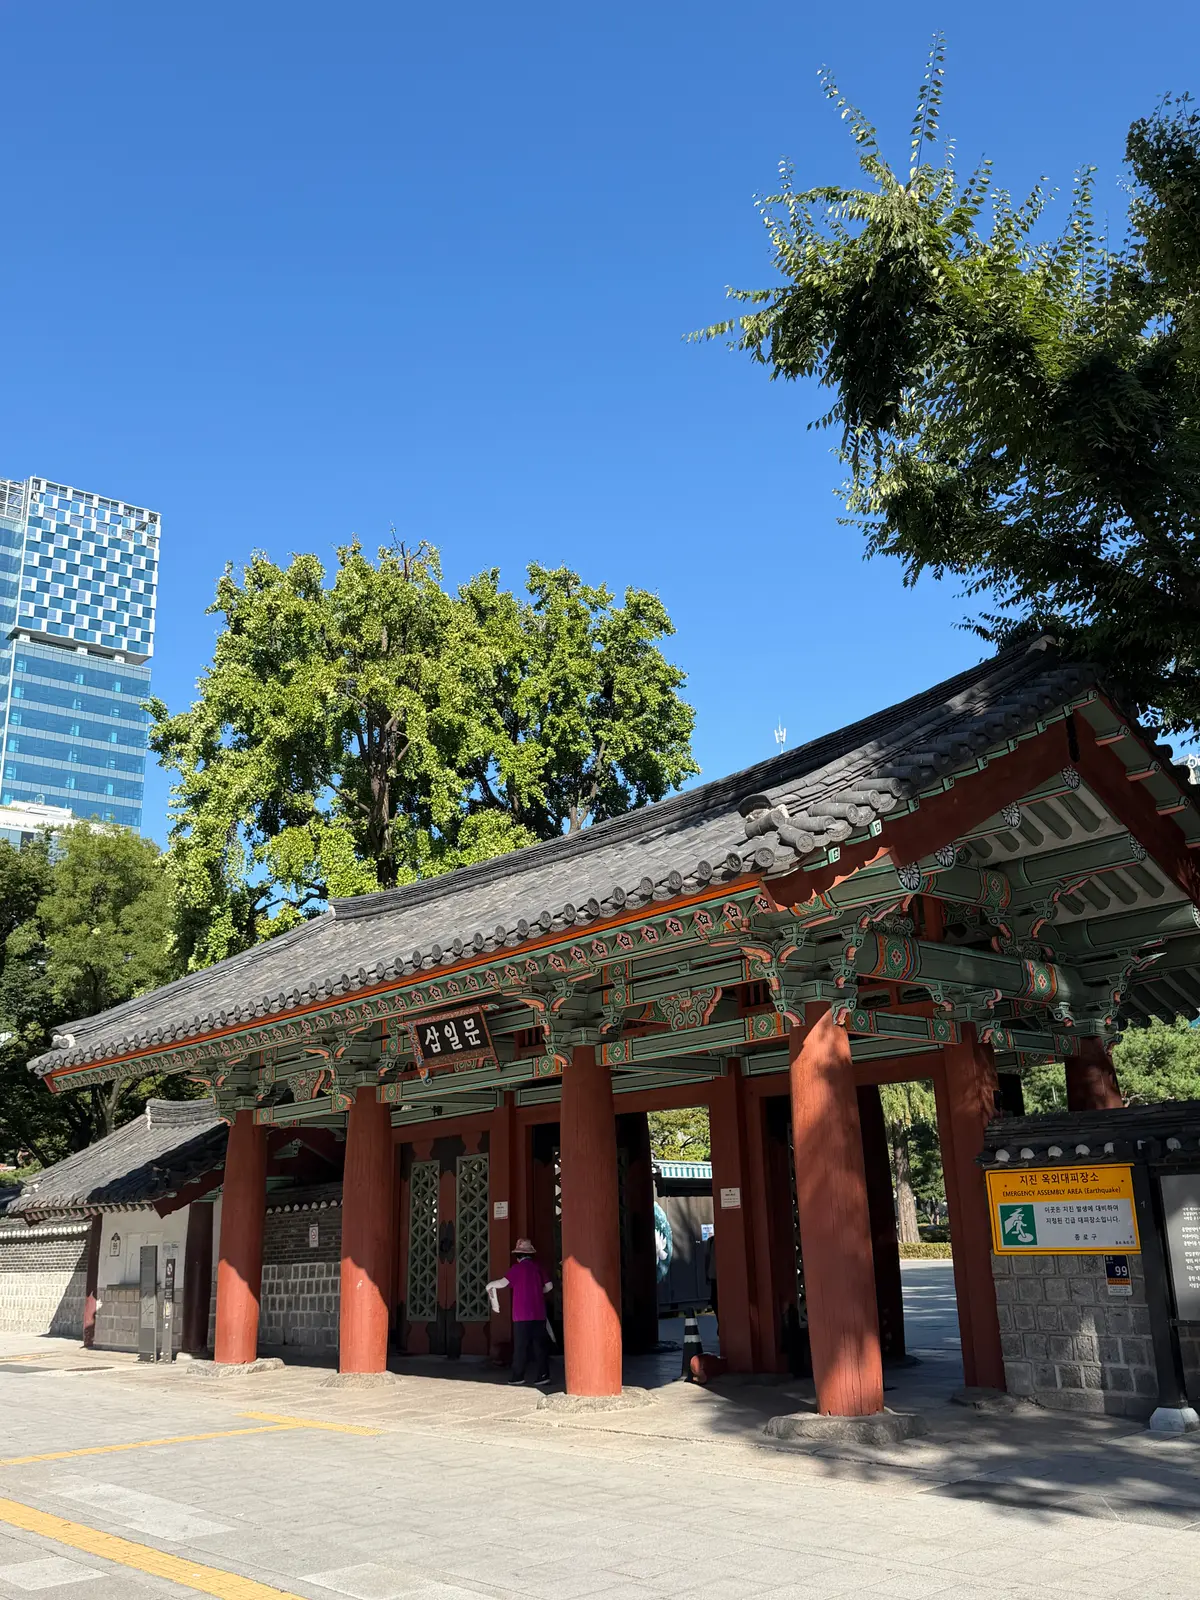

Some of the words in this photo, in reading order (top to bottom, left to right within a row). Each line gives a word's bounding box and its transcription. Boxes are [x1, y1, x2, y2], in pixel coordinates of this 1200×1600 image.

[425, 1018, 481, 1053] 삼일문
[1019, 1174, 1037, 1186] 지진
[1041, 1172, 1099, 1184] 옥외대피장소
[1084, 1186, 1121, 1194] (Earthquake)
[1095, 1204, 1119, 1212] 대비하여
[1046, 1217, 1063, 1225] 지정된
[1077, 1216, 1121, 1224] 대피장소입니다.
[1114, 1265, 1128, 1277] 99
